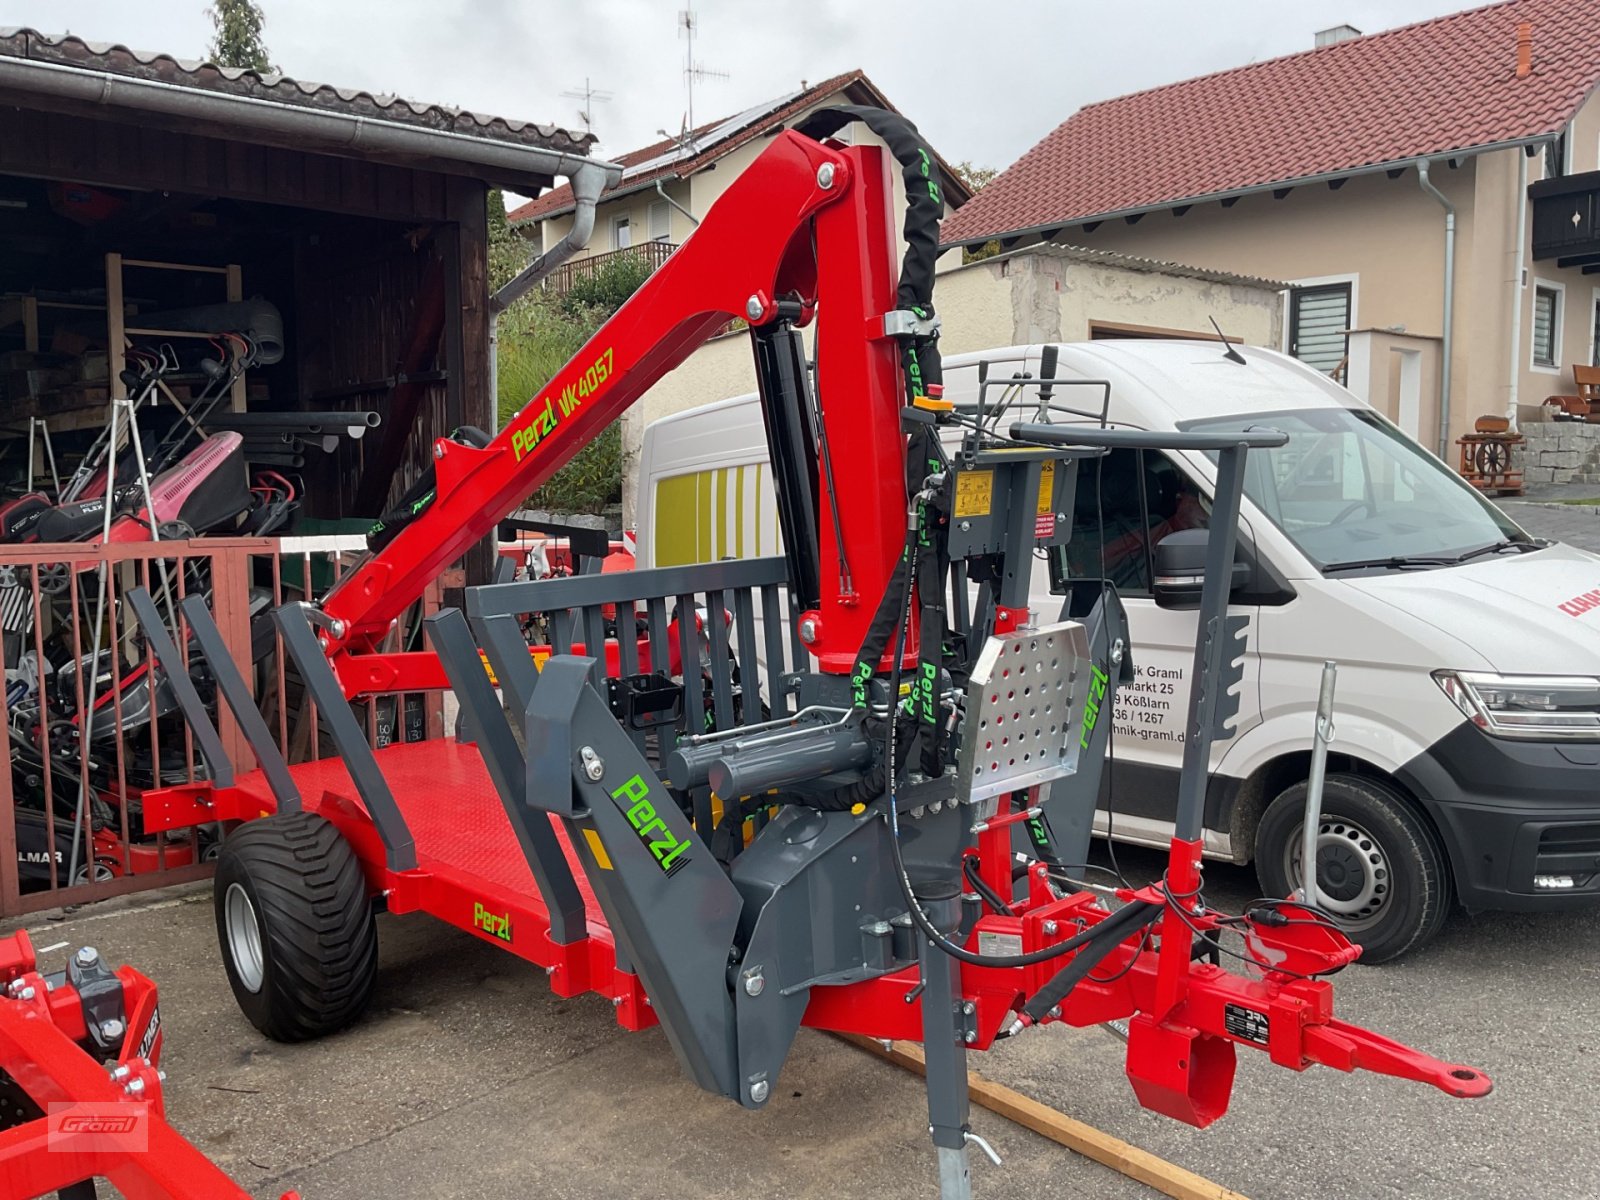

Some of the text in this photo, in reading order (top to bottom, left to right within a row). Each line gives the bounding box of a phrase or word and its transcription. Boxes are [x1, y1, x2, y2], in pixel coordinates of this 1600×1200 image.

[511, 396, 558, 462] Perzl
[82, 504, 104, 514] FLEX
[1146, 665, 1183, 680] Graml
[852, 661, 873, 709] Perzl
[921, 661, 937, 724] Perzl
[1159, 682, 1175, 695] 25
[1124, 694, 1170, 710] Kößlarn
[1137, 711, 1164, 725] 1267
[1112, 722, 1186, 743] hnik-graml.d
[611, 774, 692, 870] Perzl
[18, 851, 63, 863] LMAR
[474, 902, 511, 941] Perzl
